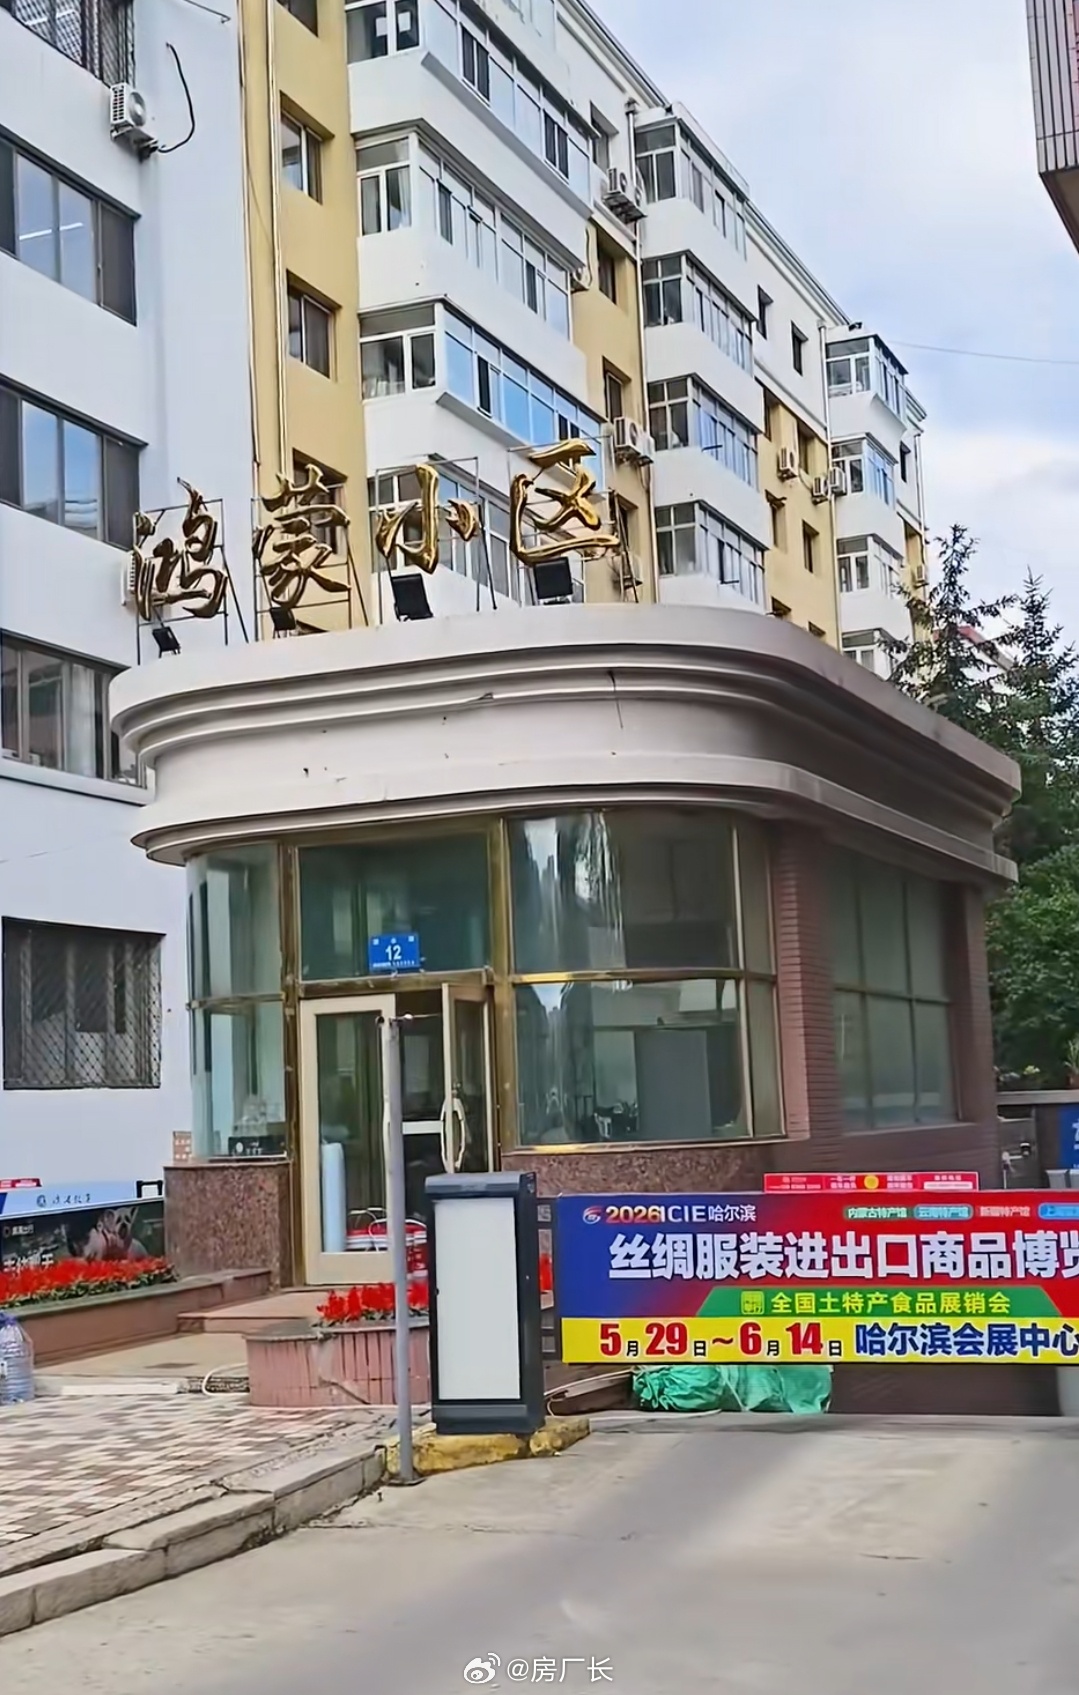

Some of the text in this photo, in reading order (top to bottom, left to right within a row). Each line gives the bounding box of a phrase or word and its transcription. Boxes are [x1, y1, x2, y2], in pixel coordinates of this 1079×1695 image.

[133, 437, 621, 620] 鸿蒙小区
[385, 945, 402, 961] 12
[771, 1292, 1010, 1314] 全国土特产食品展销会
[855, 1323, 1079, 1357] 哈尔滨会展中心
